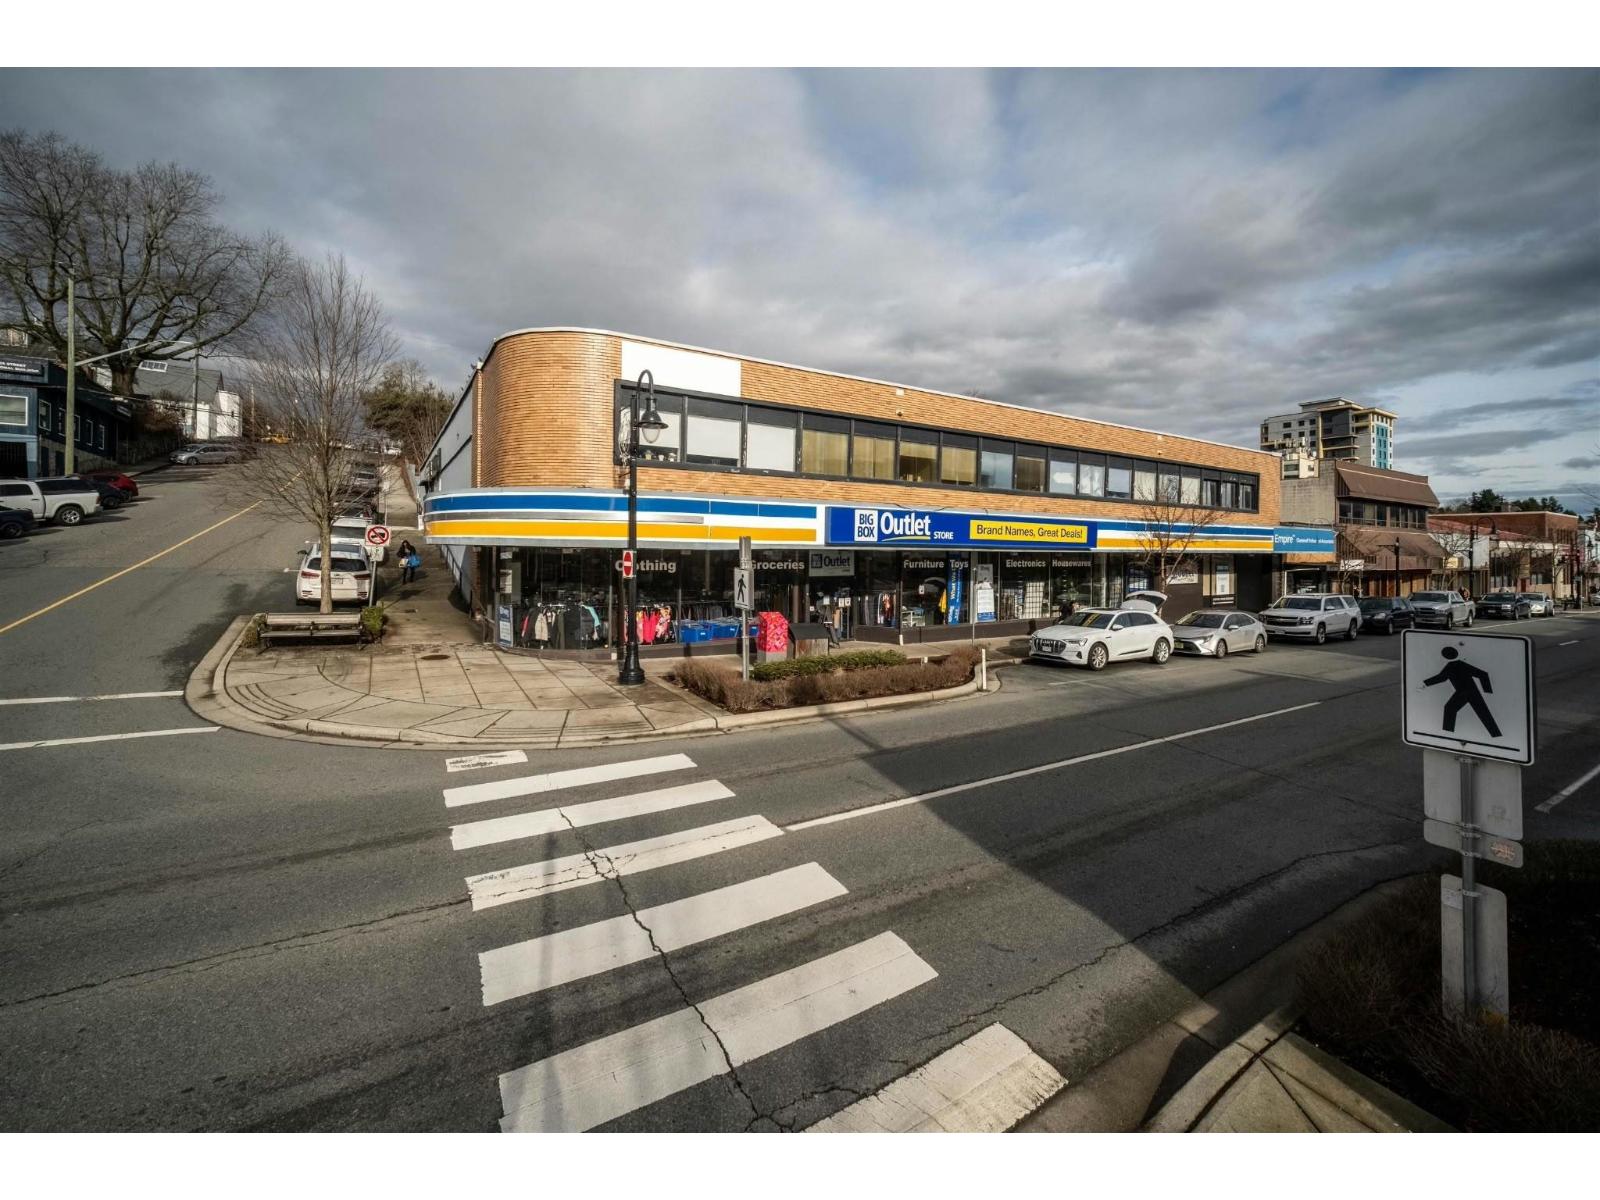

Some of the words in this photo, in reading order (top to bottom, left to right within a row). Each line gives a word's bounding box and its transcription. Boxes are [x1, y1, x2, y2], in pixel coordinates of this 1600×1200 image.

[859, 513, 874, 525] BIG
[880, 511, 931, 536] Outlet
[857, 526, 875, 538] BOX
[933, 531, 954, 540] STORE
[976, 524, 1003, 536] Brand
[1005, 526, 1036, 538] Names,
[1038, 527, 1059, 538] Great
[1060, 529, 1083, 539] Deals!
[615, 559, 677, 573] Cthing
[823, 555, 850, 567] Outlet
[903, 559, 944, 568] Furniture
[949, 559, 969, 570] Toys
[1005, 559, 1046, 568] Electronics
[1052, 559, 1092, 567] Housewares
